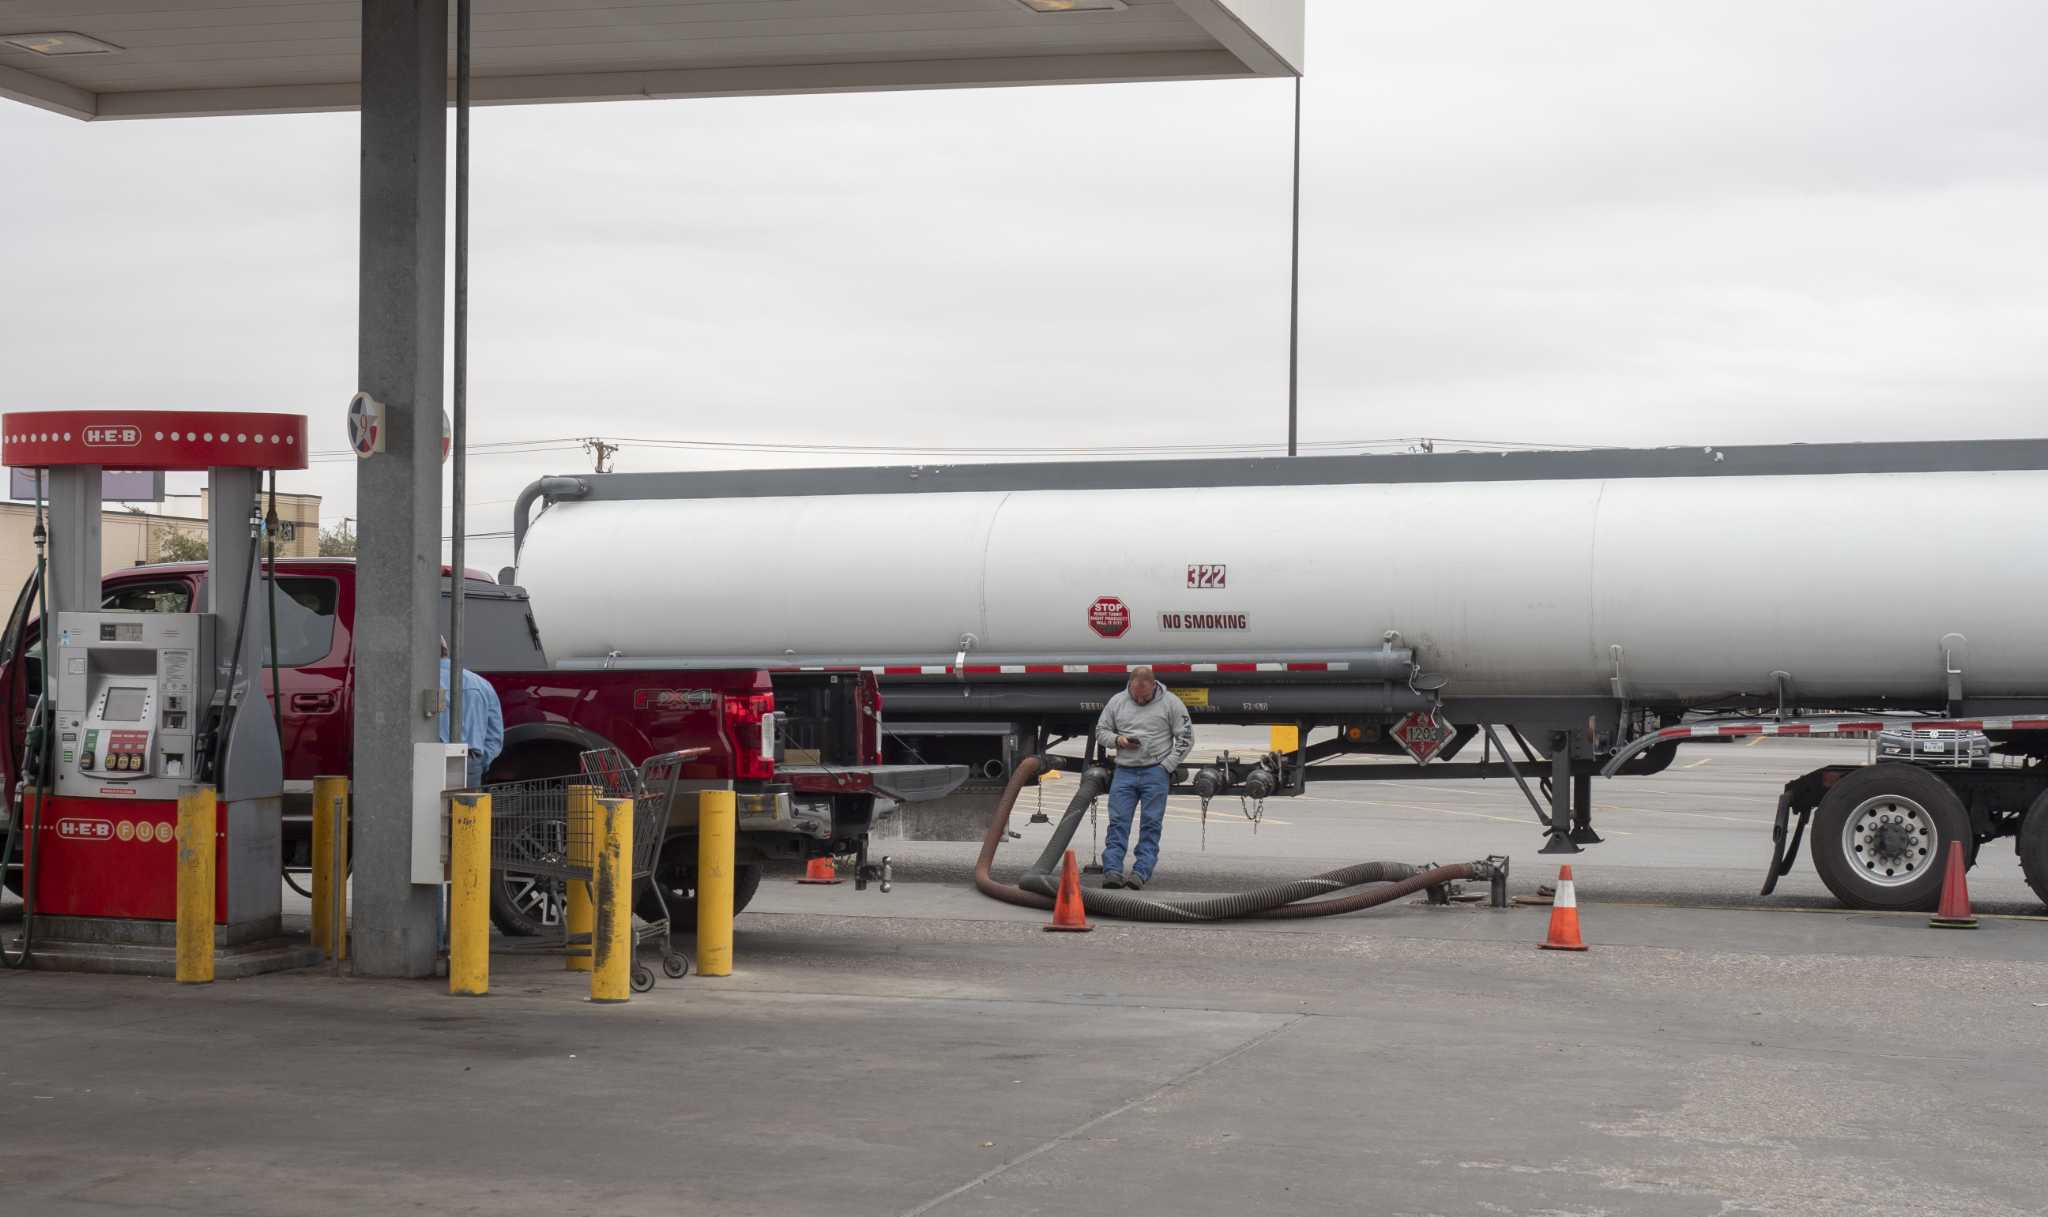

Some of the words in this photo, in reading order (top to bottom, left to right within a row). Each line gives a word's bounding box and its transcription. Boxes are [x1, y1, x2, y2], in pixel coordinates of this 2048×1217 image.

[1187, 564, 1226, 588] 322
[1094, 603, 1122, 612] STOP
[1162, 614, 1181, 629] NO
[1184, 614, 1247, 629] SMOKING
[118, 821, 173, 842] FUE
